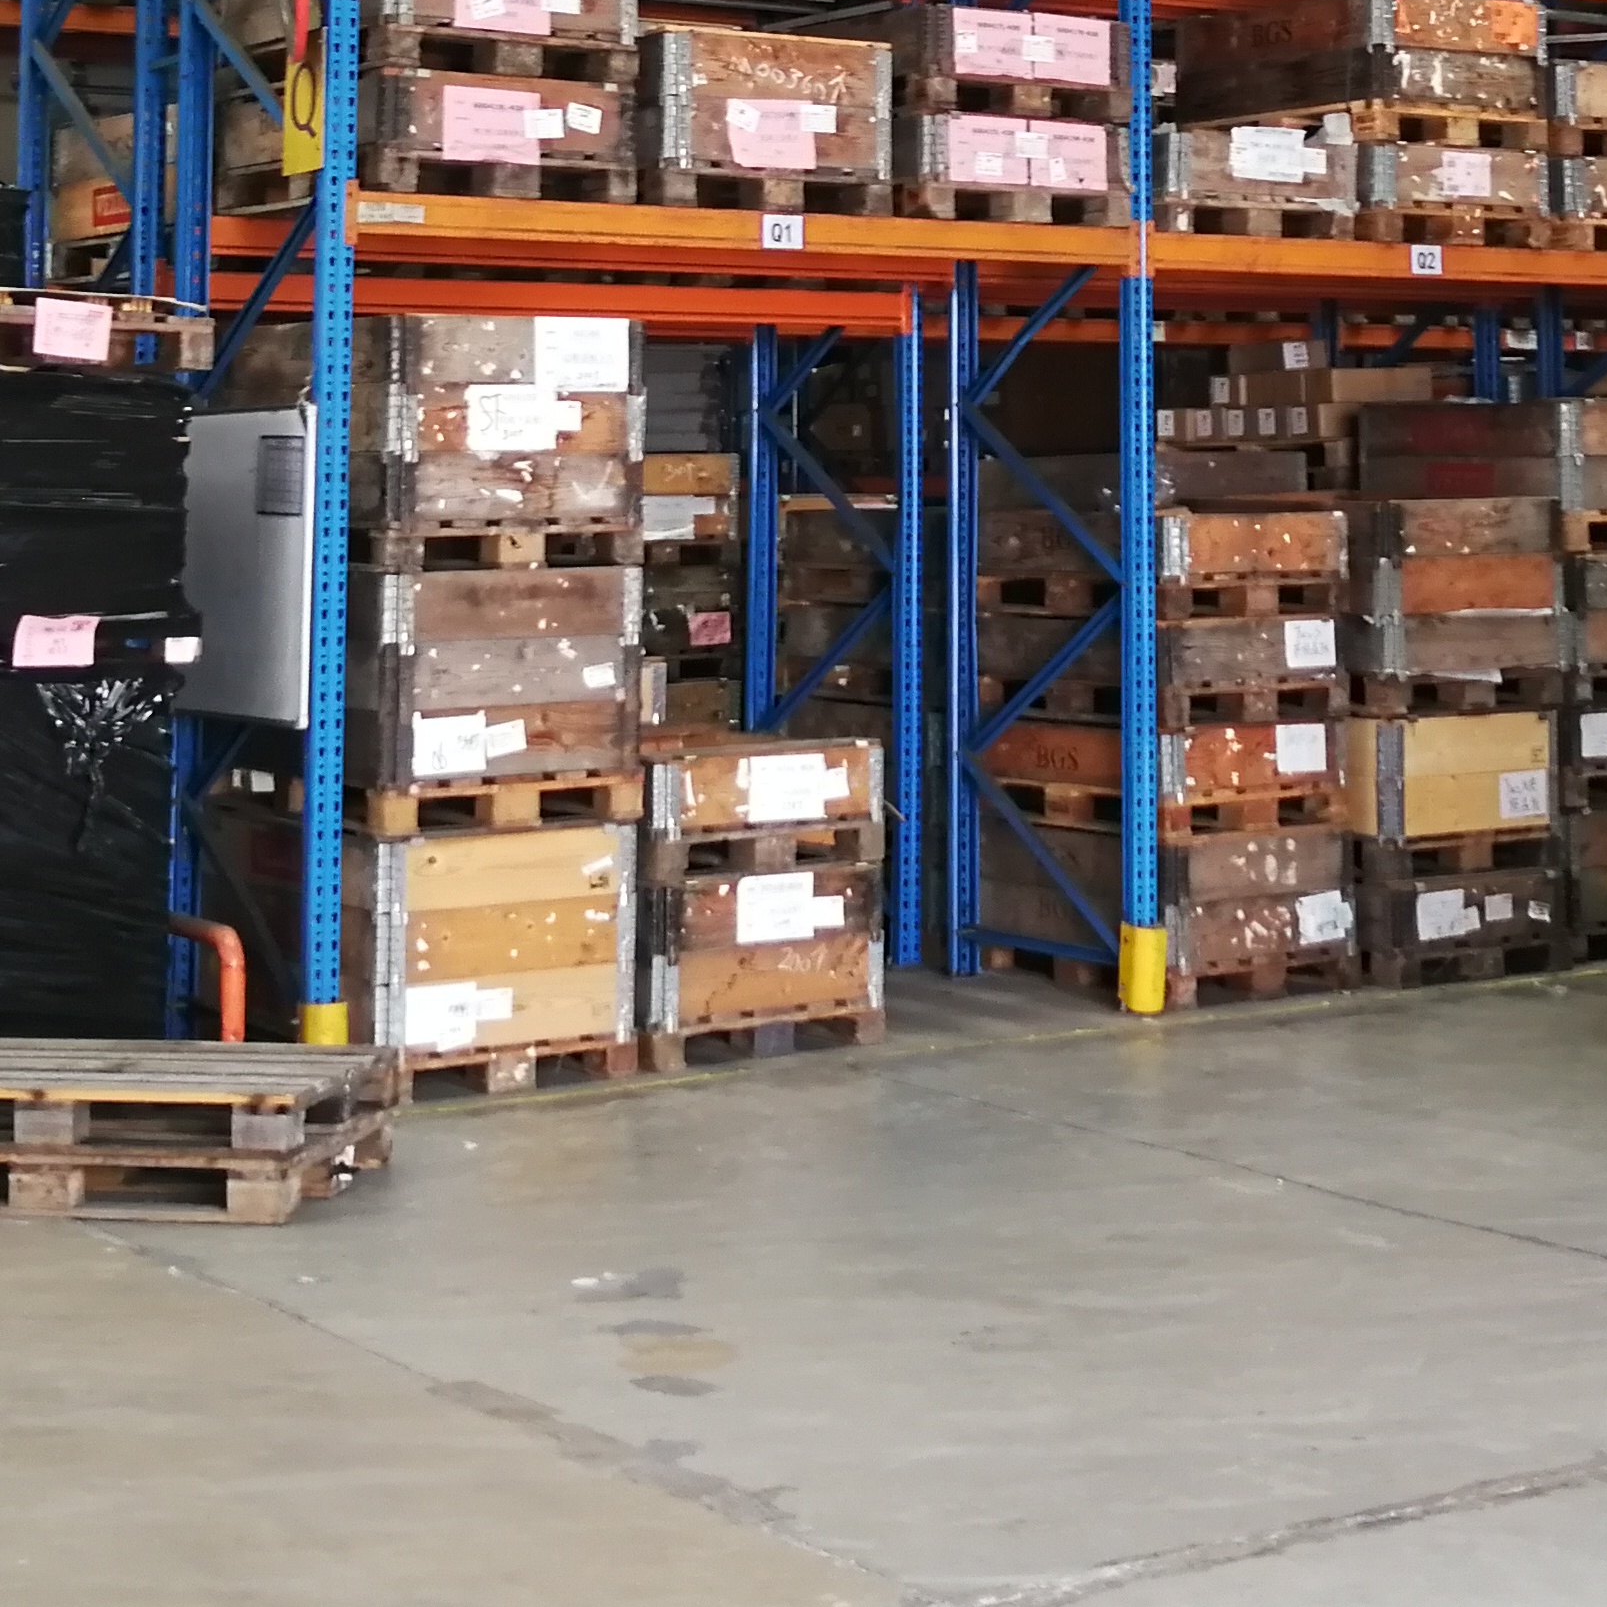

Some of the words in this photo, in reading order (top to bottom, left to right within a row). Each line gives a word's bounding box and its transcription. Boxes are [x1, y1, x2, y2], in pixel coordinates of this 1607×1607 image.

[1252, 19, 1292, 48] BGS
[292, 65, 319, 135] Q
[771, 223, 793, 243] Q1
[1417, 252, 1436, 270] Q2
[1035, 744, 1079, 772] BGS
